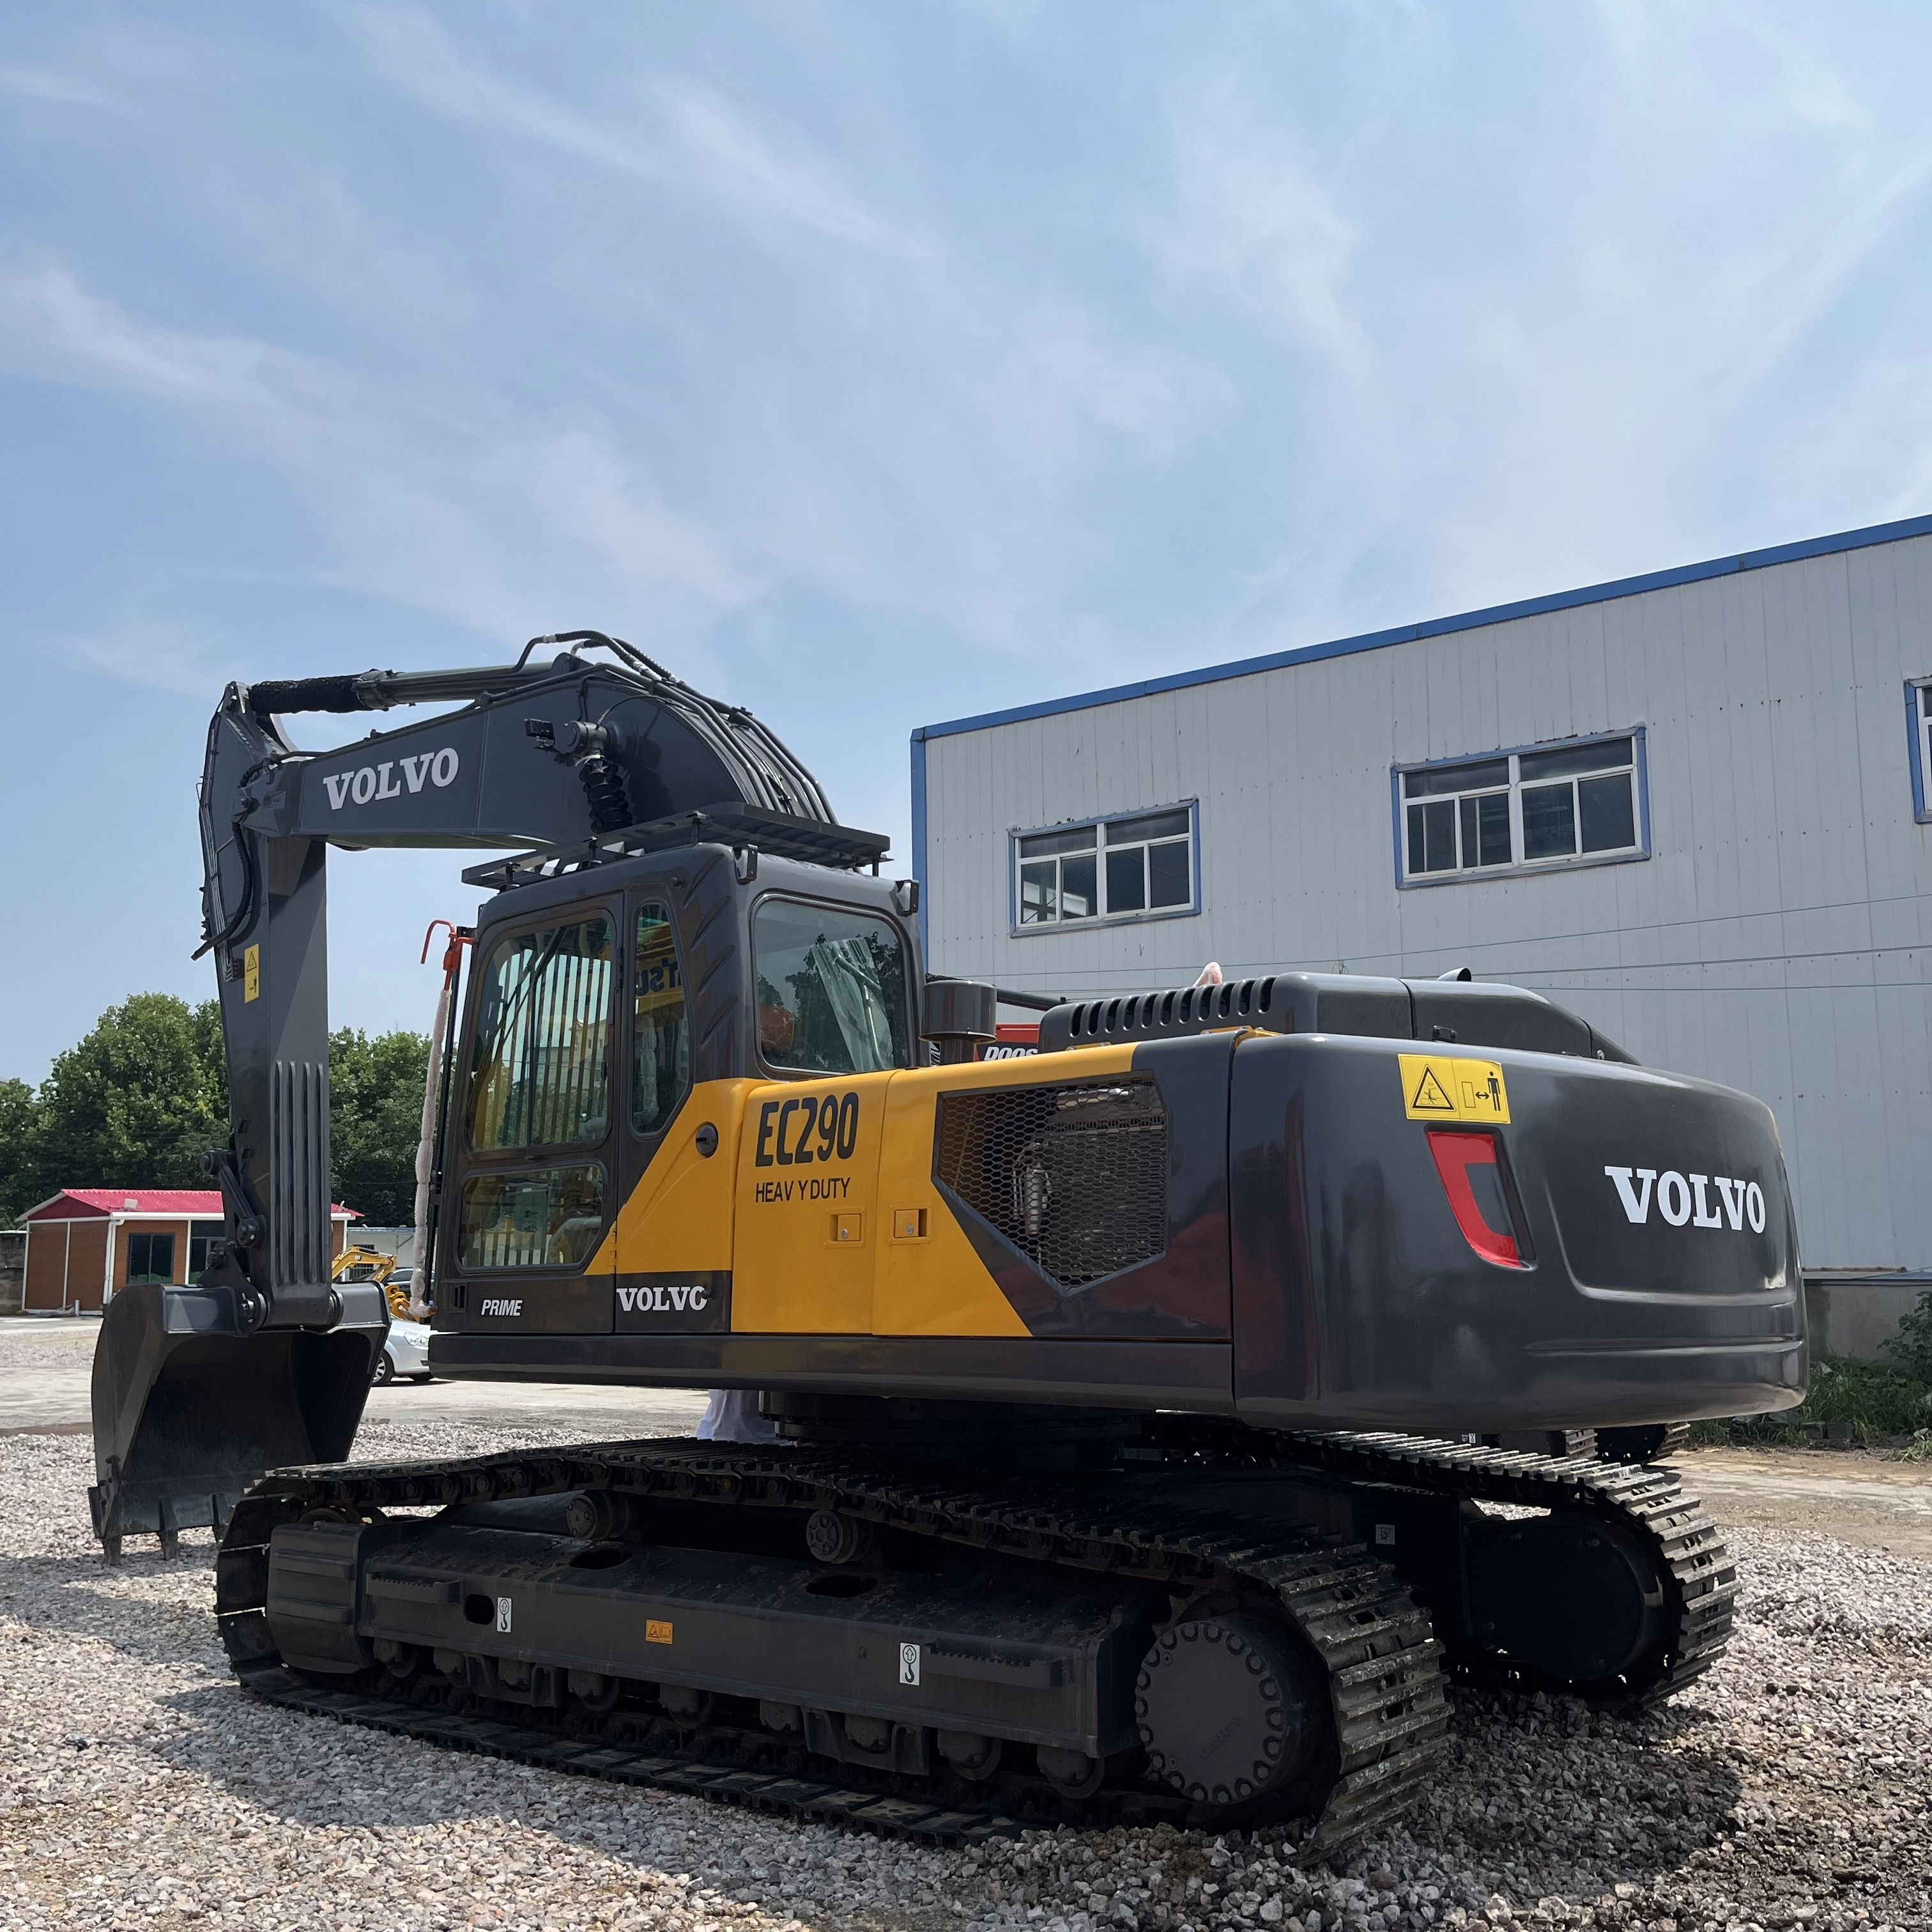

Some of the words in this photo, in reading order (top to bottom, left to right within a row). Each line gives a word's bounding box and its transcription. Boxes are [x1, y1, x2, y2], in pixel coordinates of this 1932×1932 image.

[323, 747, 459, 810] VOLVO
[755, 1092, 859, 1167] EC290
[1604, 1165, 1766, 1234] VOLVO
[481, 1300, 523, 1316] PRIME
[617, 1286, 708, 1312] VOLVO
